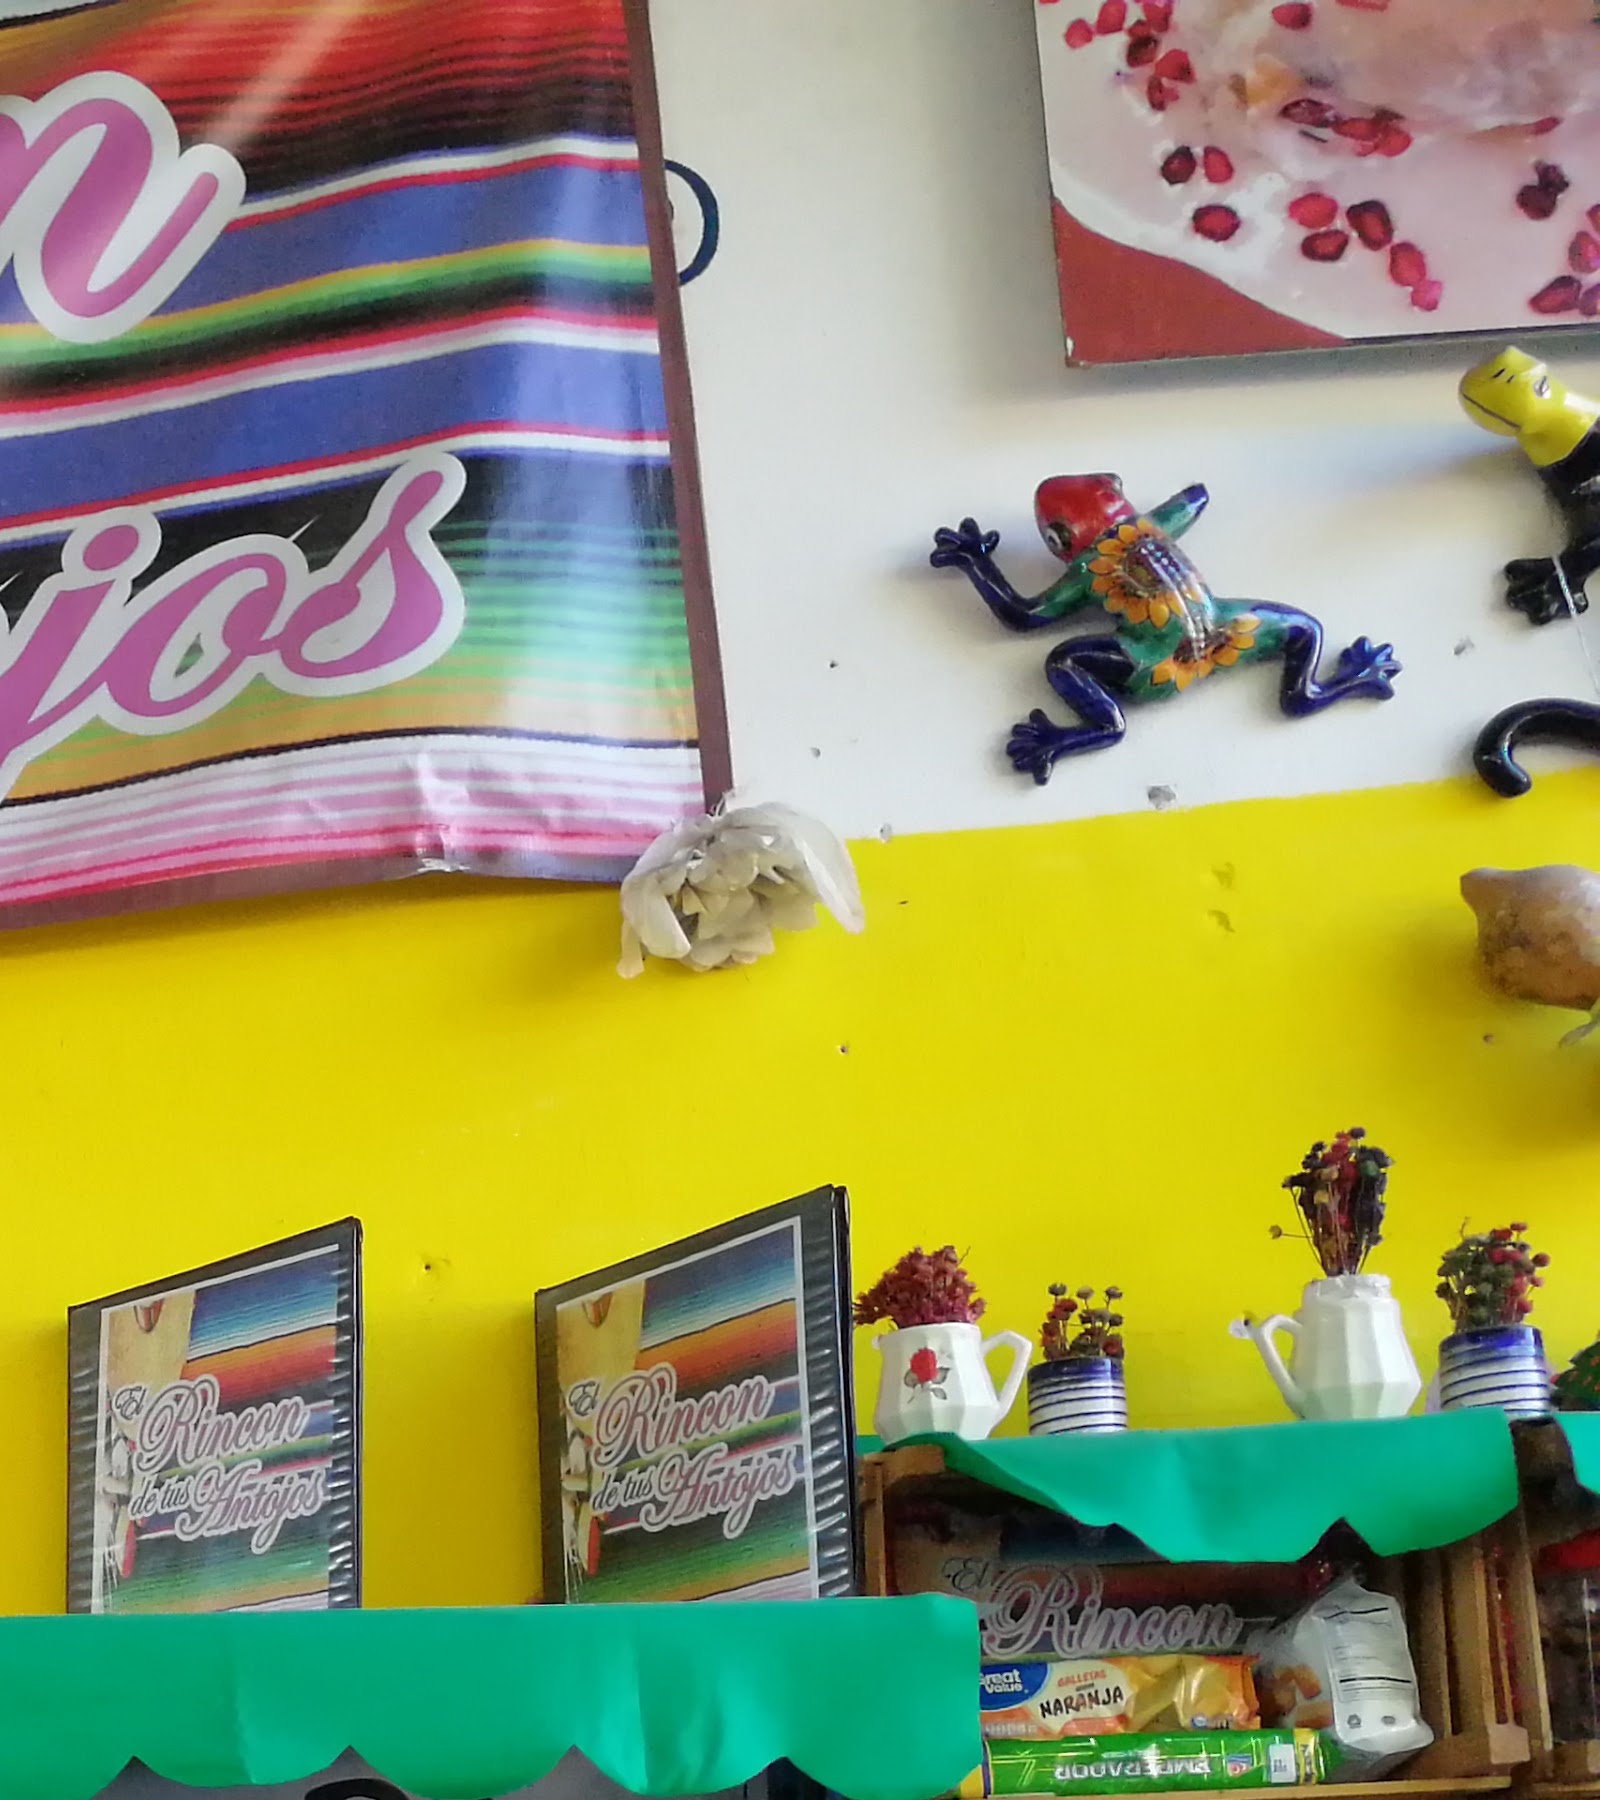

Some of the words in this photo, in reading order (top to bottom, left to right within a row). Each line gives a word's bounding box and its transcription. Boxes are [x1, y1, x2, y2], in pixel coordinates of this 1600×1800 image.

[134, 1375, 311, 1472] Rincon
[593, 1363, 775, 1467] Rincon
[130, 1475, 160, 1519] de
[176, 1460, 326, 1554] Antojos
[591, 1470, 619, 1510] de
[640, 1443, 795, 1539] Antojos
[981, 1564, 1243, 1659] Rincon
[984, 1680, 1023, 1695] Value
[1039, 1687, 1125, 1719] NARANJA
